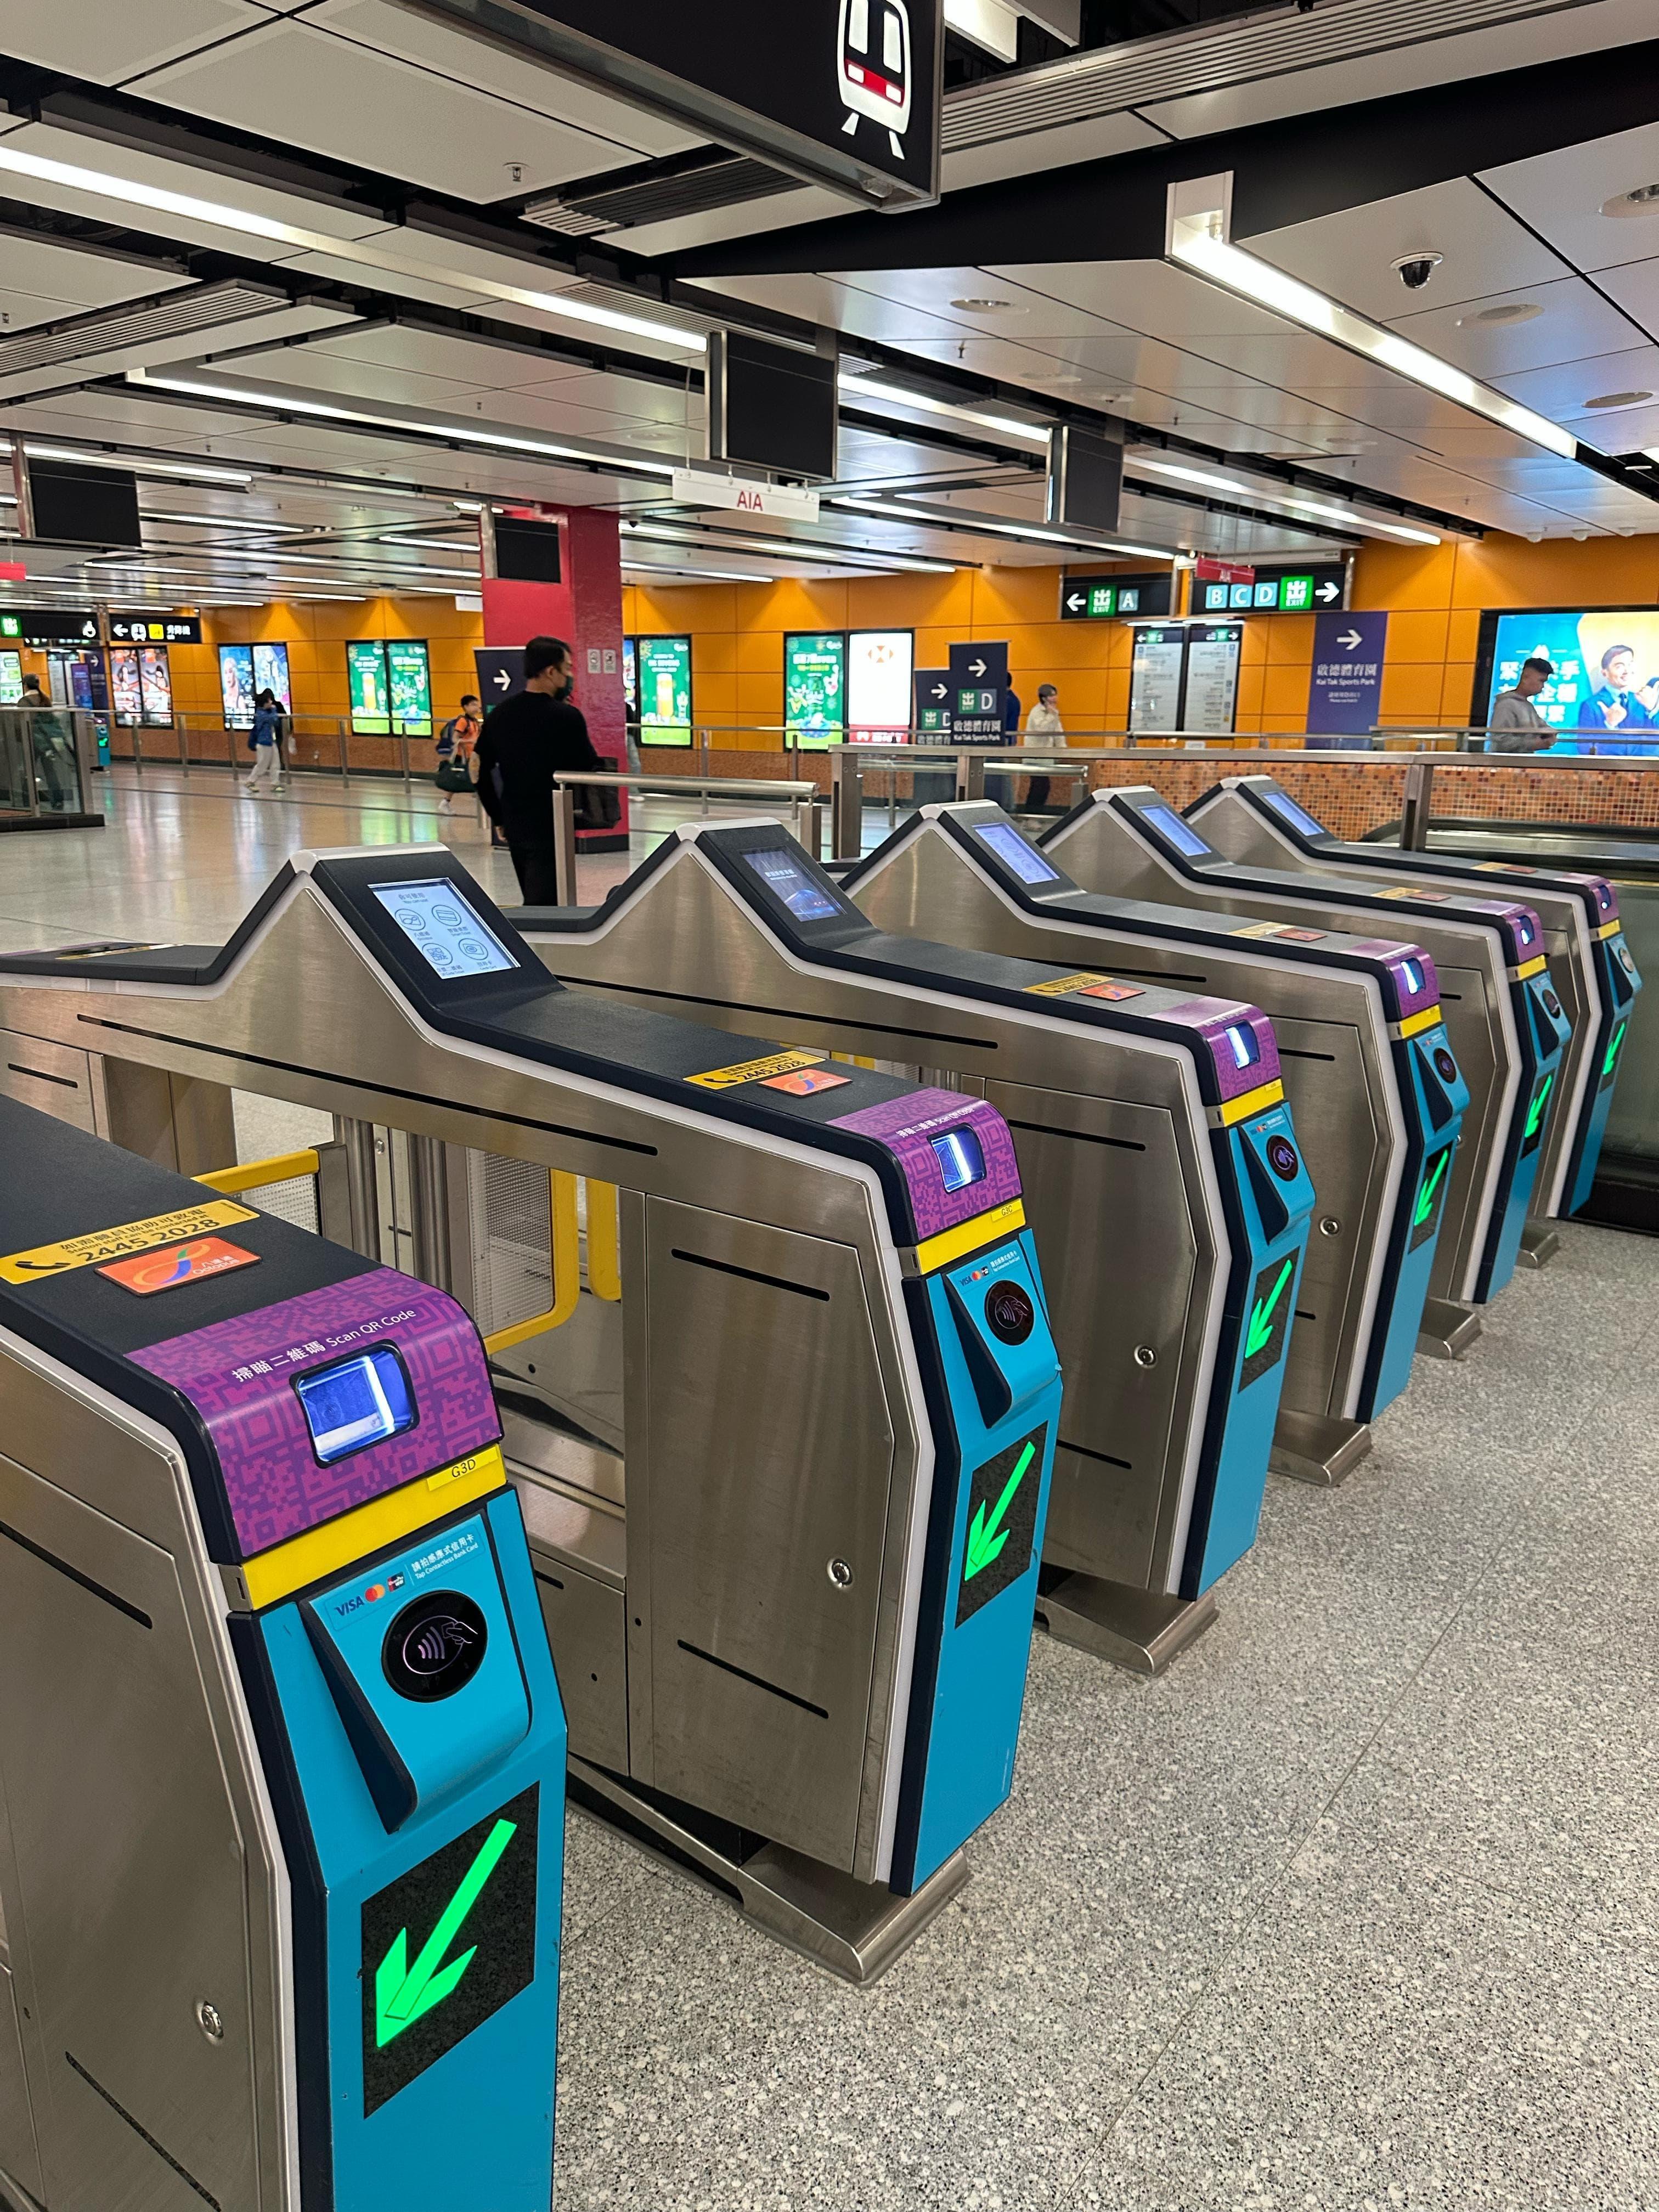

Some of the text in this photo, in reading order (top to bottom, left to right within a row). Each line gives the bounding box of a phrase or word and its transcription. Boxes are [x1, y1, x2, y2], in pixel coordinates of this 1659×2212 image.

[737, 490, 763, 511] AIA
[1094, 589, 1111, 606] 出
[1211, 586, 1273, 605] B C D
[1286, 580, 1307, 599] 出
[1122, 592, 1134, 608] A
[1339, 678, 1359, 687] Sports
[981, 693, 992, 709] D
[736, 1069, 773, 1080] 2445
[770, 1060, 805, 1071] 2028
[1001, 1205, 1013, 1216] G3C
[67, 1243, 103, 1254] Station
[103, 1236, 123, 1244] staff
[155, 1216, 198, 1231] contacted
[77, 1219, 220, 1261] 2445 2028
[960, 1276, 973, 1287] VISA
[326, 1308, 416, 1347] Scan QR Code
[232, 1340, 326, 1382] 掃瞄二維碼
[452, 1459, 476, 1478] G3D
[411, 1534, 474, 1572] 請拍感應式信用卡
[425, 1556, 454, 1574] Contactless
[454, 1549, 467, 1559] Bank
[466, 1542, 479, 1552] Card
[335, 1595, 365, 1616] VISA
